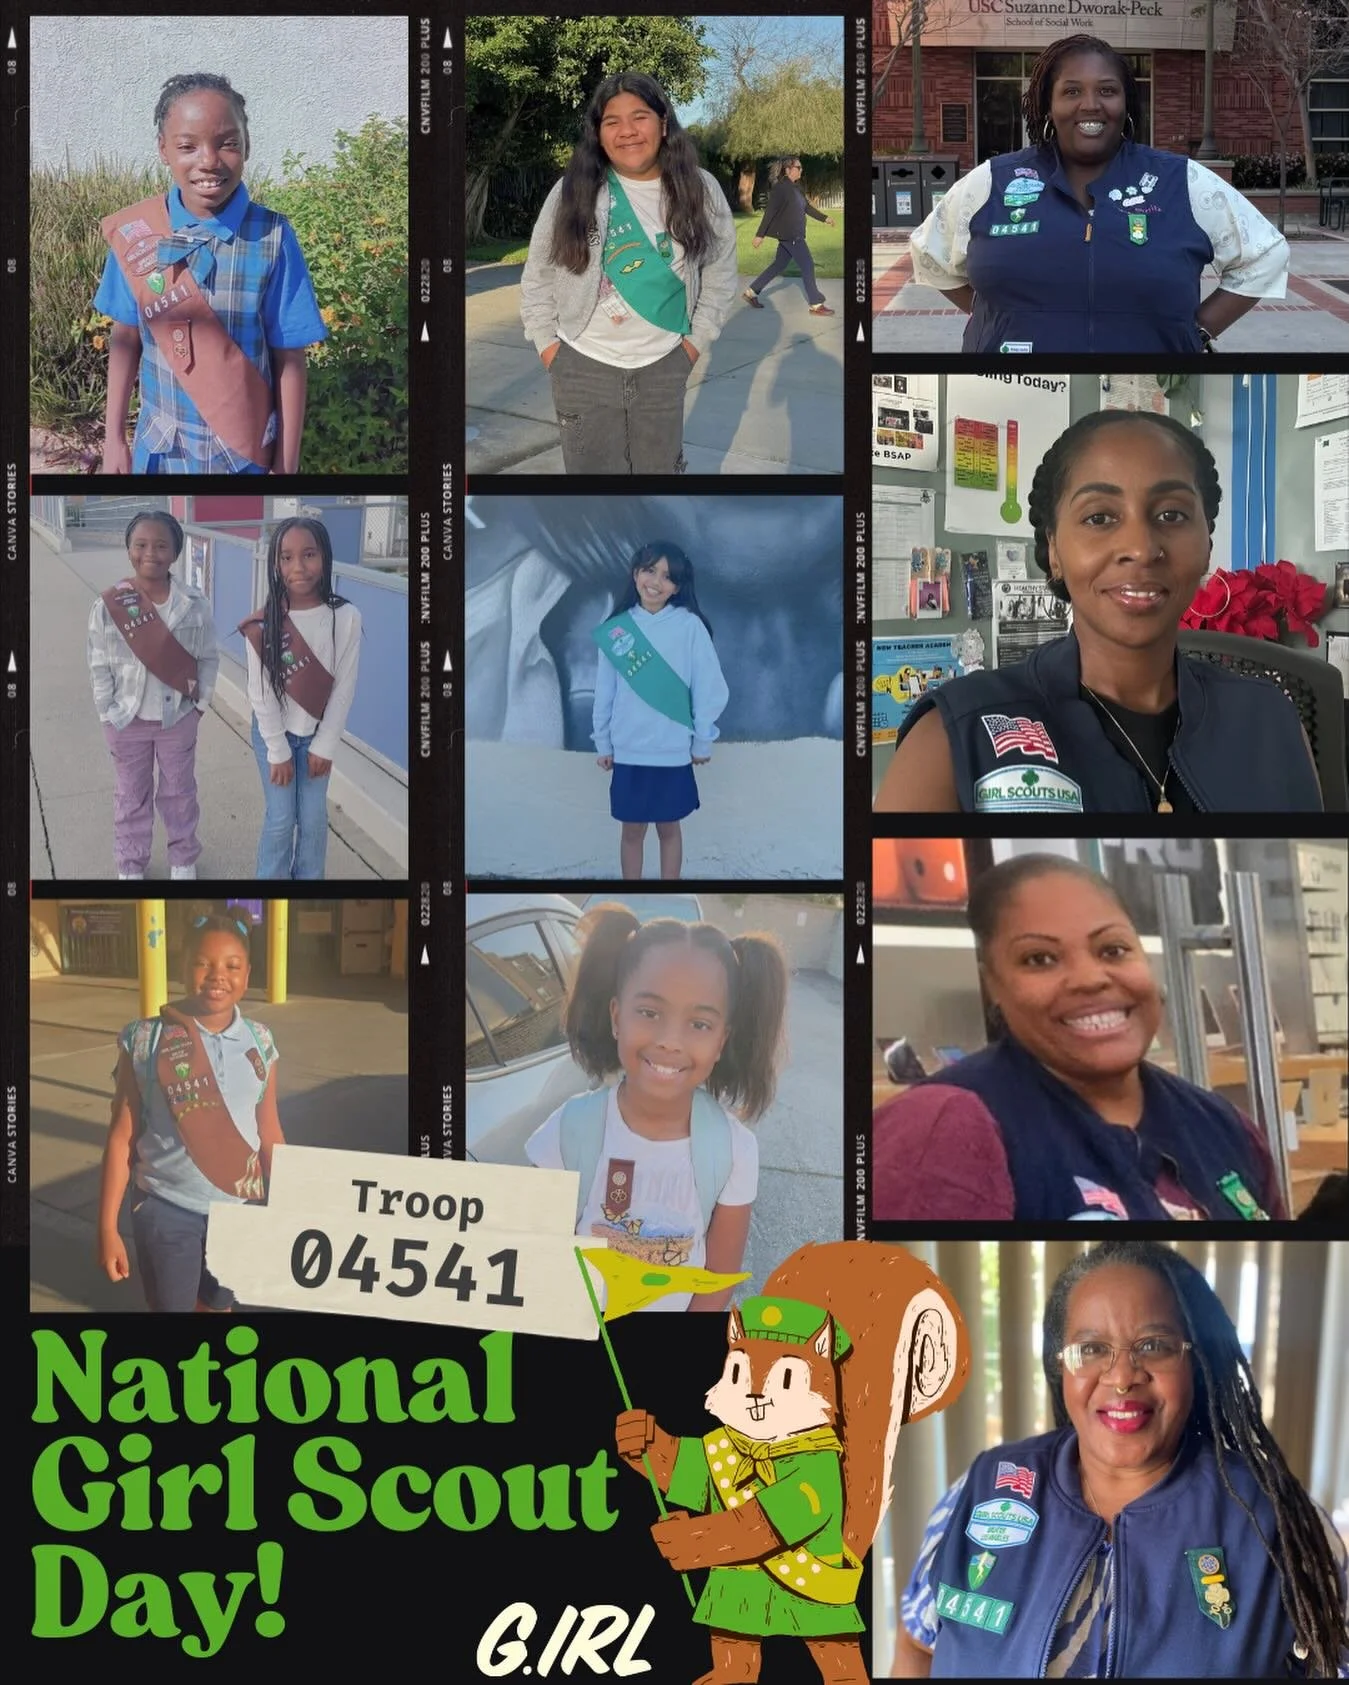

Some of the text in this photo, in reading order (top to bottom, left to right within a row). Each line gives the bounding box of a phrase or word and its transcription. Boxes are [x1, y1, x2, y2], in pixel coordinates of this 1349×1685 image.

[969, 0, 1163, 17] USC Suzanne Dworak-Peck
[1006, 18, 1094, 28] School of Social Work
[991, 221, 1039, 236] 04541
[144, 284, 189, 319] 04541
[1015, 374, 1067, 392] Today?
[883, 450, 911, 460] BSAP
[979, 787, 1078, 801] GIRL SCOUTS USA
[167, 1077, 208, 1095] 04541
